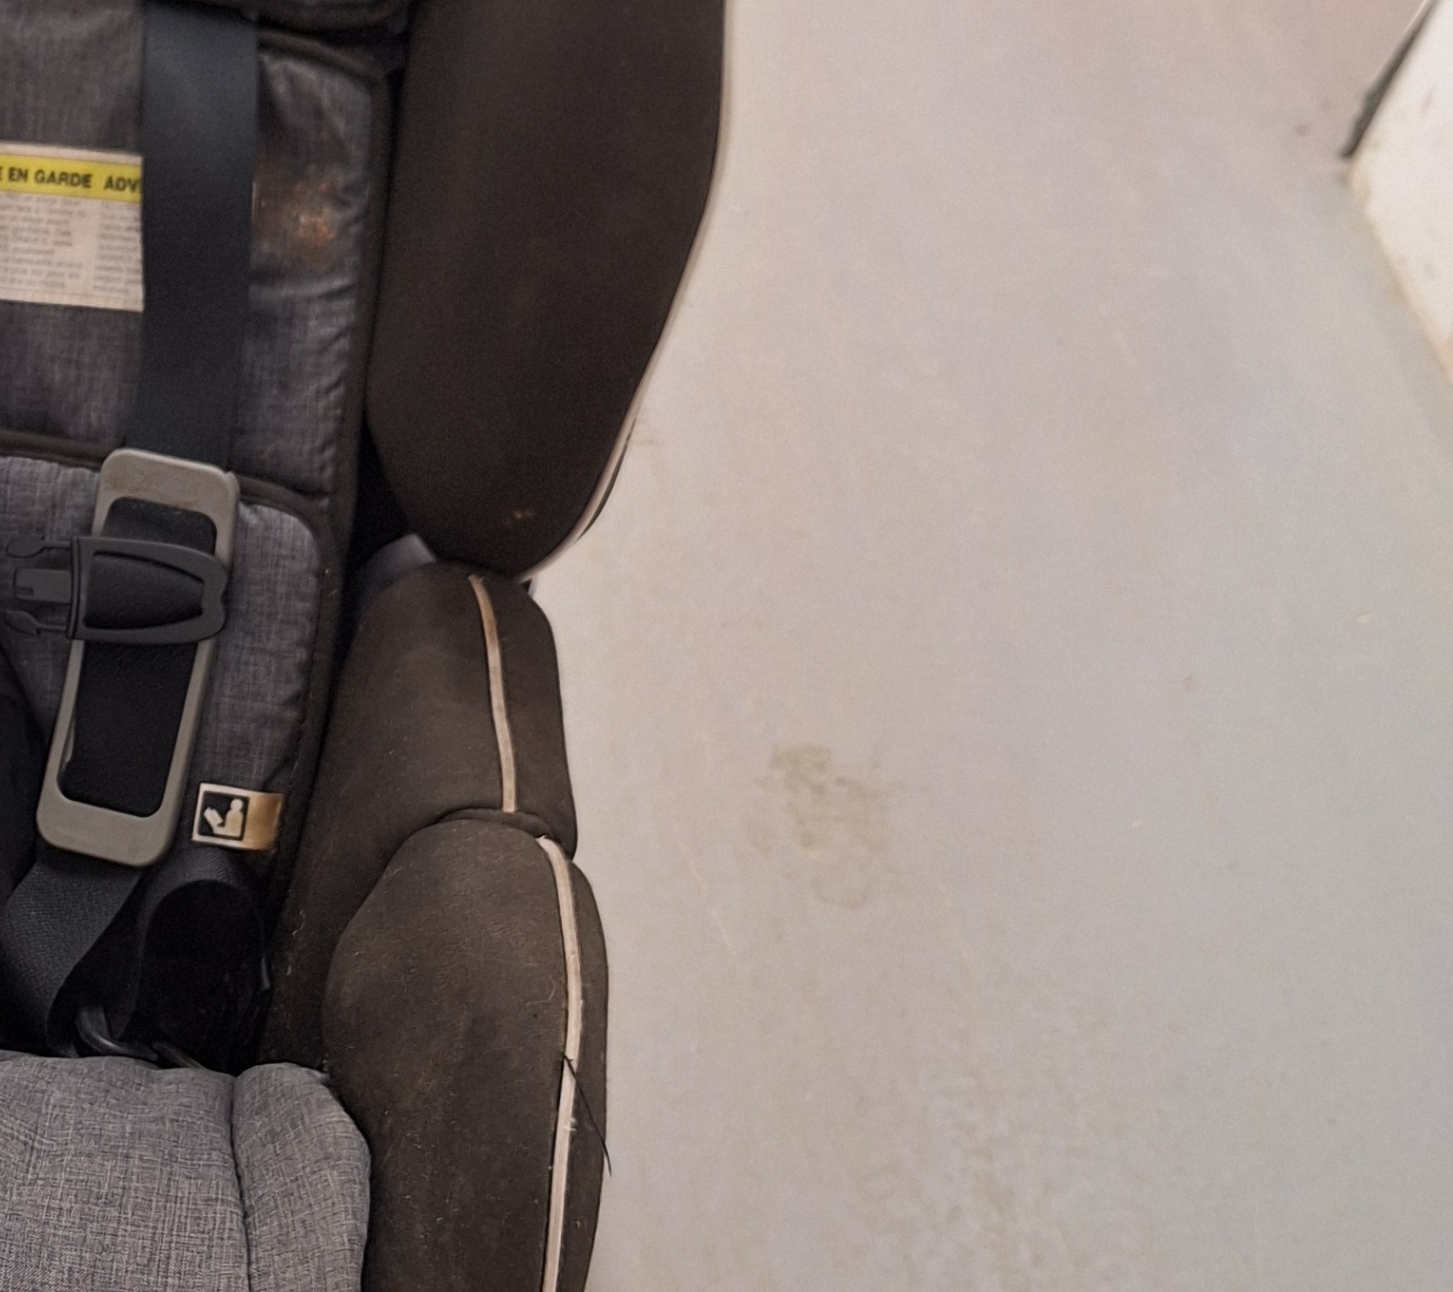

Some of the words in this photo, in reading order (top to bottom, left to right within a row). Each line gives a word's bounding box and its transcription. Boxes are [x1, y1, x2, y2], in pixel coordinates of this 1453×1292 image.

[8, 167, 29, 183] EN
[34, 169, 92, 189] GARDE
[103, 175, 142, 194] ADV
